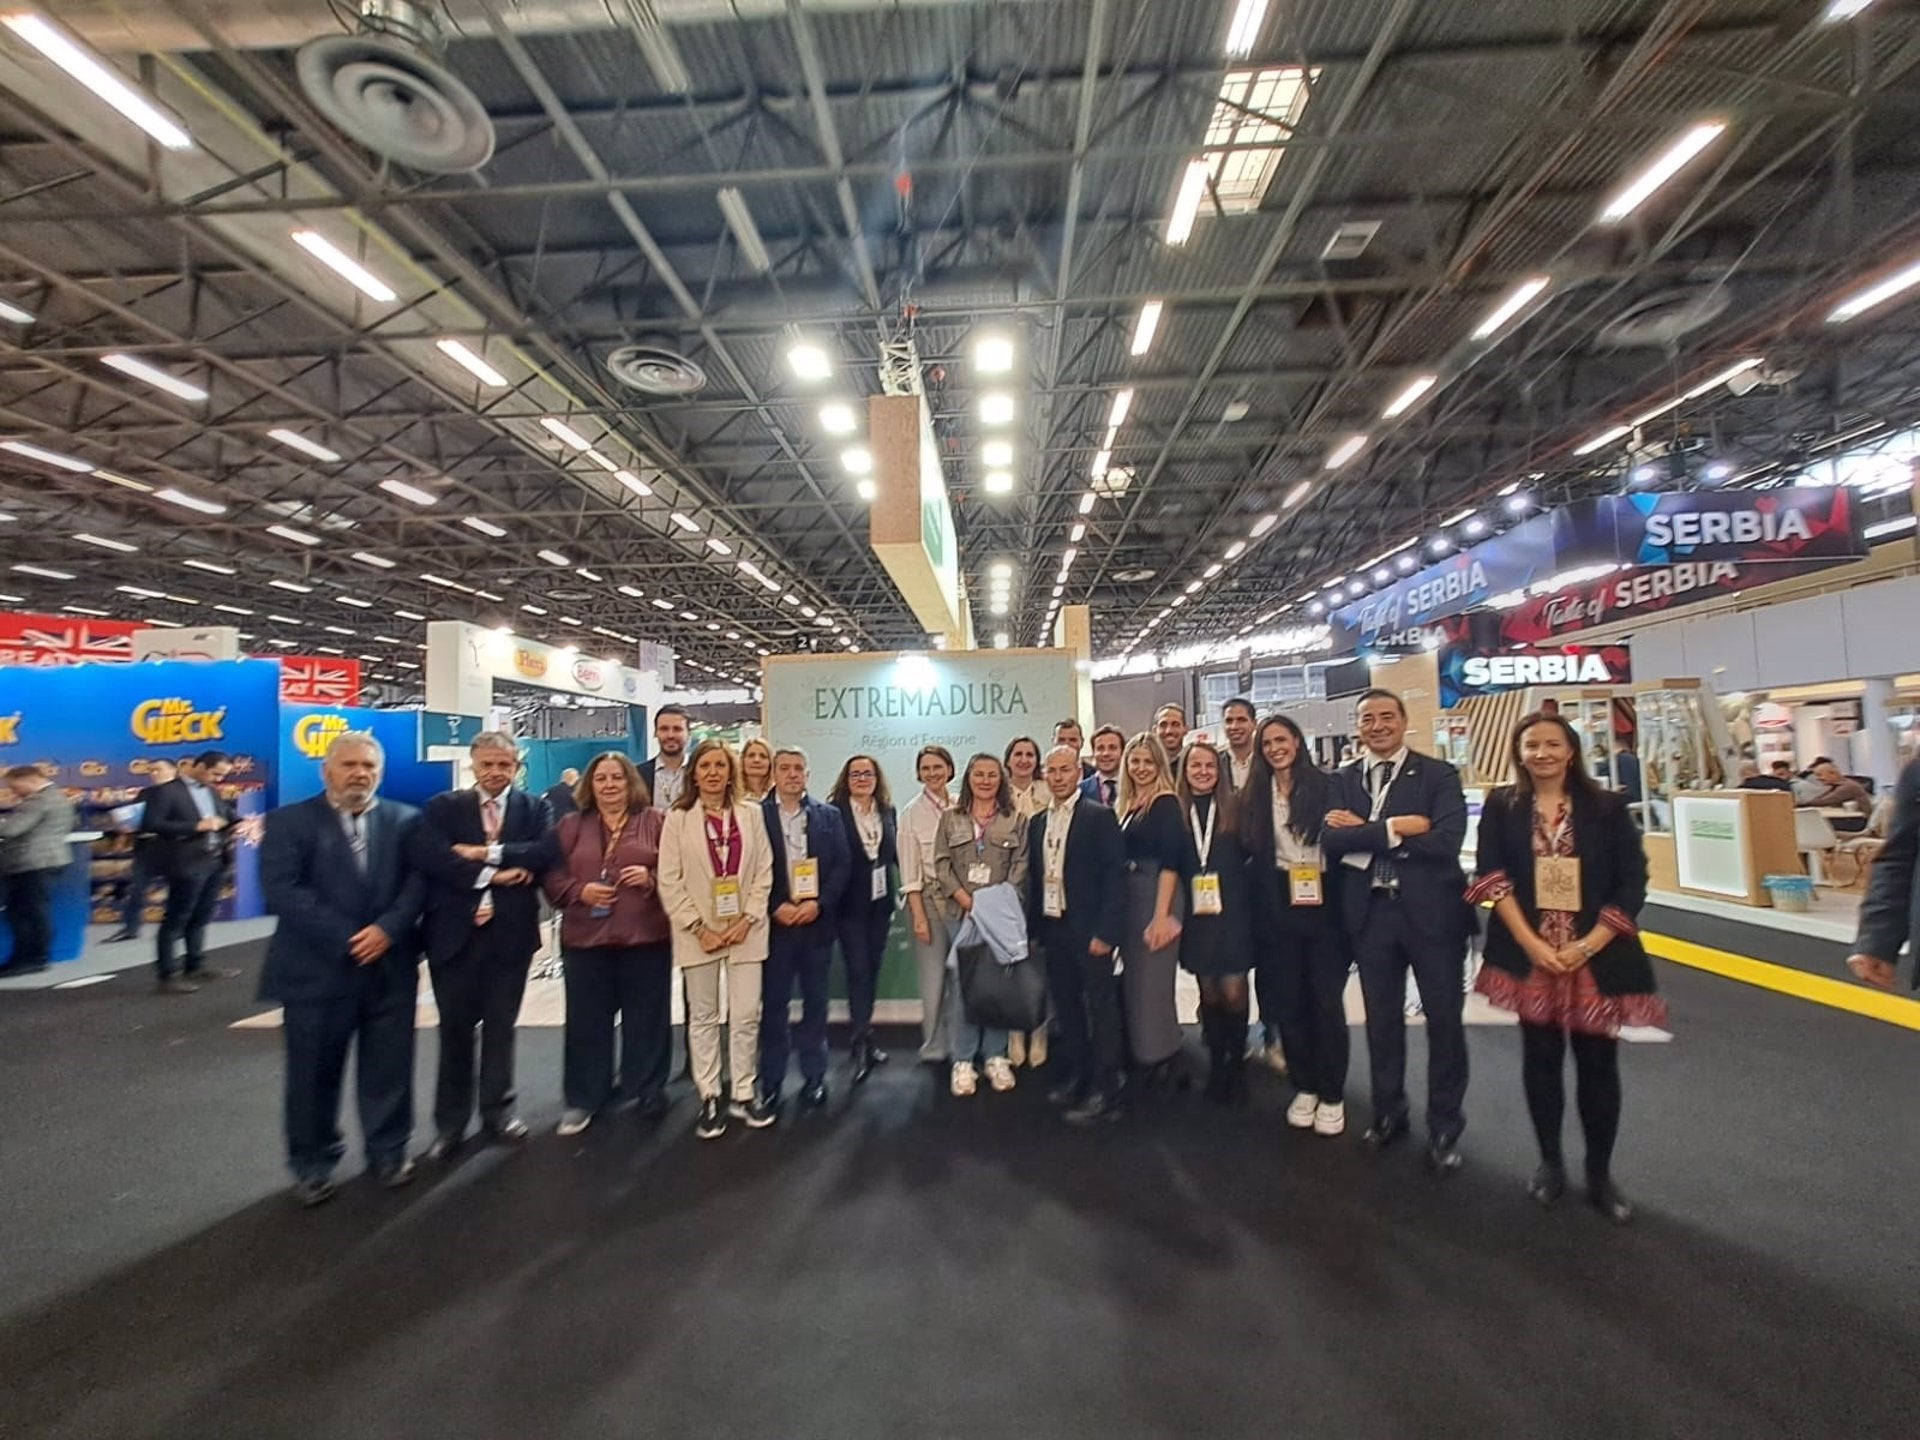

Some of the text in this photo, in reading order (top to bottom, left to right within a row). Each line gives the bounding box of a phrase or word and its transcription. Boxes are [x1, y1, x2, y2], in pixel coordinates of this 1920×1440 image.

[1645, 508, 1814, 547] SERBIA
[1407, 560, 1488, 616] SERBIA
[1615, 562, 1739, 608] SERBIA
[1463, 653, 1611, 687] SERBIA
[814, 682, 1028, 720] EXTREMADURA
